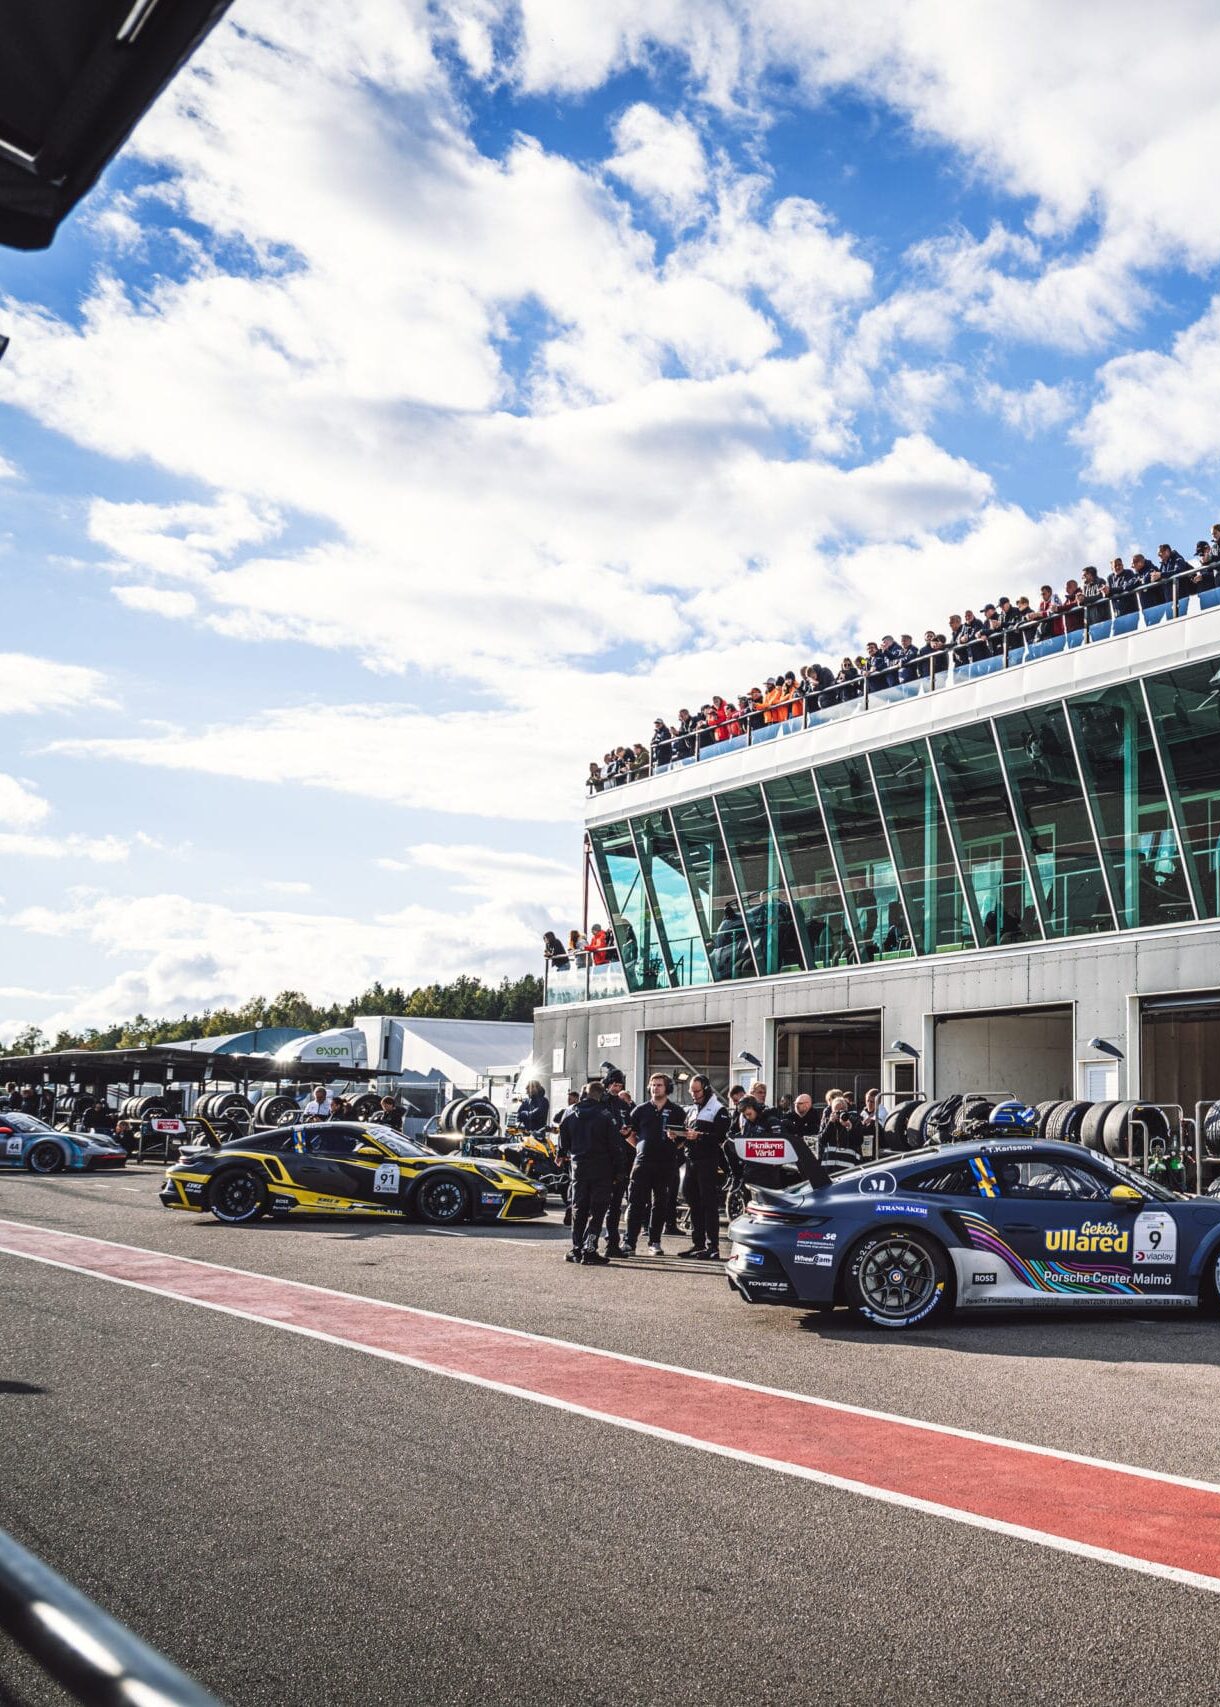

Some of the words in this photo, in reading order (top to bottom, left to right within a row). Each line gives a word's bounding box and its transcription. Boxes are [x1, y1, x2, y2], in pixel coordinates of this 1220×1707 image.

[316, 1046, 349, 1056] exion
[9, 1143, 19, 1151] 44
[747, 1141, 784, 1150] Teknikens
[755, 1149, 776, 1157] Värld
[380, 1173, 395, 1185] 91
[1081, 1221, 1119, 1236] Gekås
[1044, 1229, 1129, 1253] Ullared
[1149, 1231, 1162, 1250] 9
[1146, 1252, 1174, 1262] viaplay
[975, 1274, 994, 1282] BOSS
[1044, 1271, 1090, 1283] Porsche
[1093, 1272, 1131, 1284] Center
[1133, 1273, 1172, 1285] Malmö
[908, 1295, 939, 1325] MICHELIN
